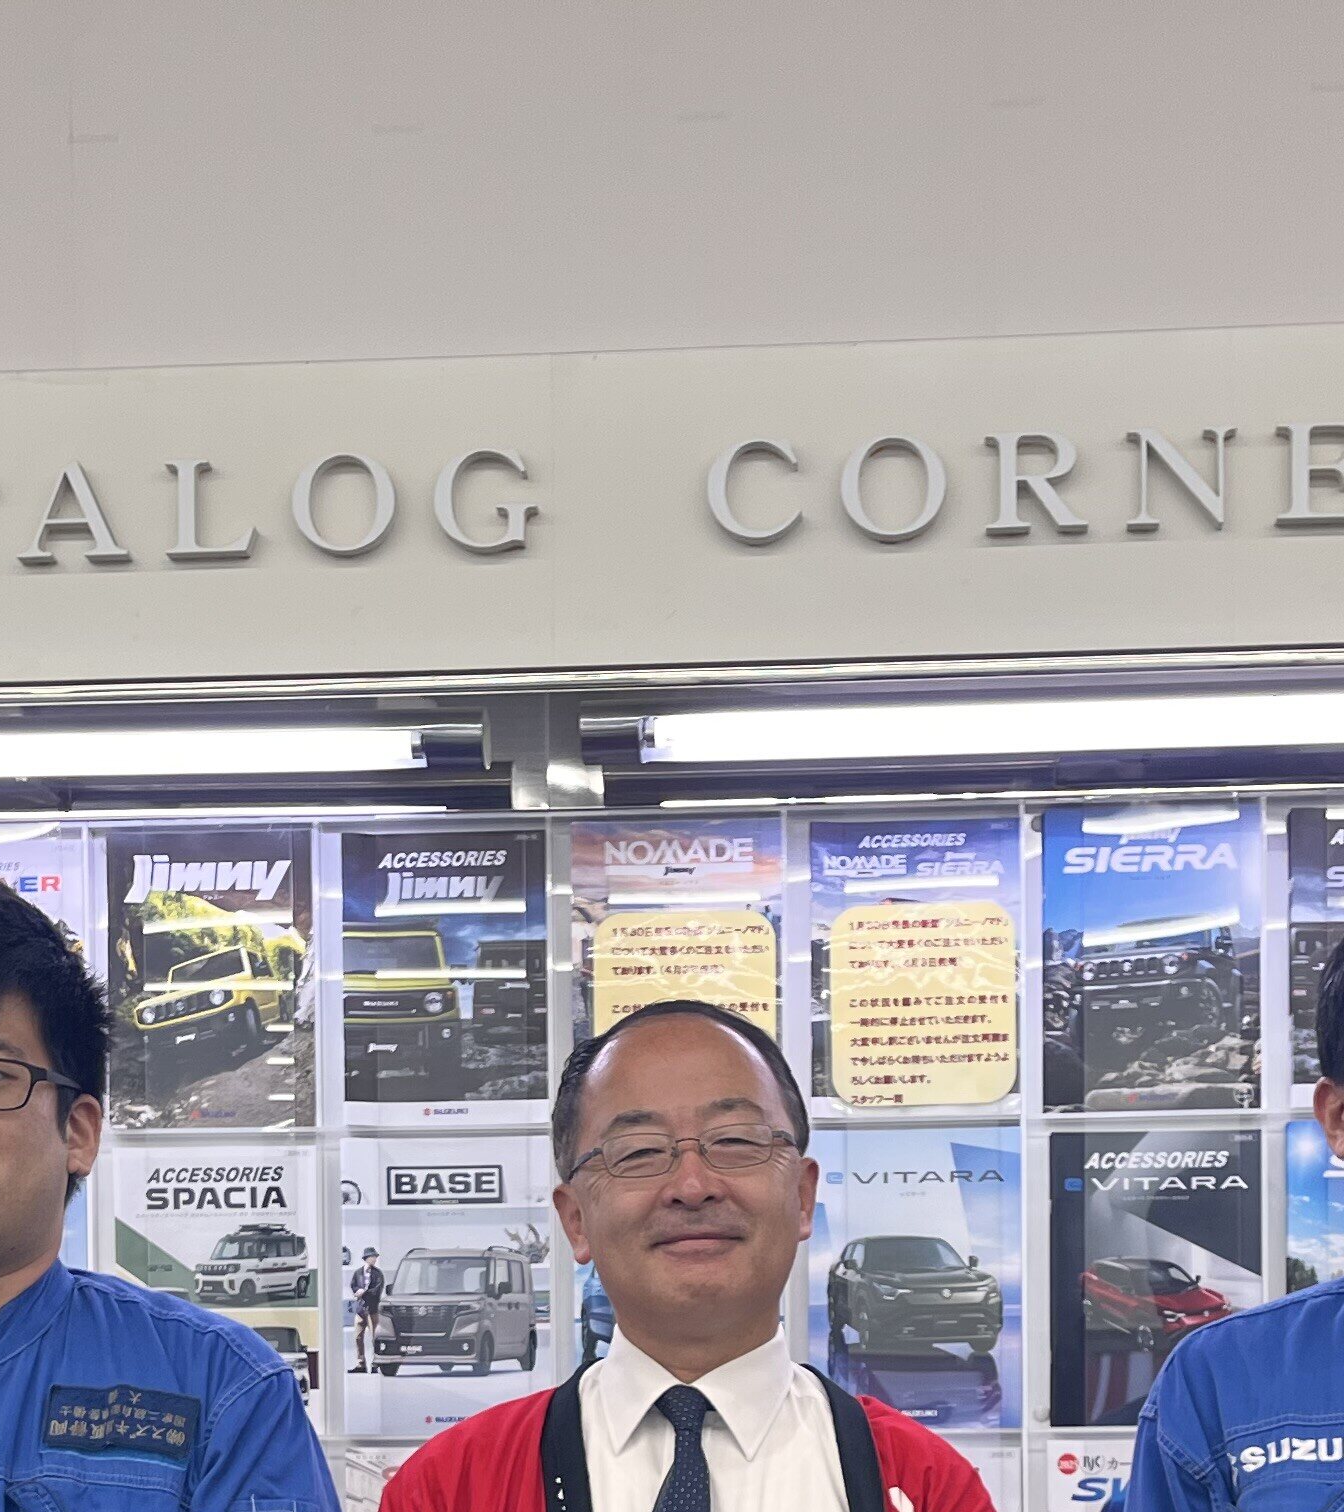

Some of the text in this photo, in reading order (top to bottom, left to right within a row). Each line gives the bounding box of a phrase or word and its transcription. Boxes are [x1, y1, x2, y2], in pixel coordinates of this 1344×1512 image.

[858, 833, 967, 849] ACCESSORIES
[378, 850, 507, 869] ACCESSORIES
[605, 838, 753, 865] NOMADE
[1062, 843, 1238, 875] SIERRA
[823, 854, 907, 871] NOMADE
[916, 860, 1006, 877] SIERRA
[124, 854, 292, 903] Jimny
[384, 872, 504, 905] Jimny
[1084, 1150, 1230, 1170] ACCESSORIES
[147, 1166, 284, 1184] ACCESSORIES
[394, 1170, 496, 1195] BASE
[853, 1170, 1005, 1185] VITARA
[1091, 1174, 1249, 1191] VITARA
[145, 1186, 287, 1210] SPACIA
